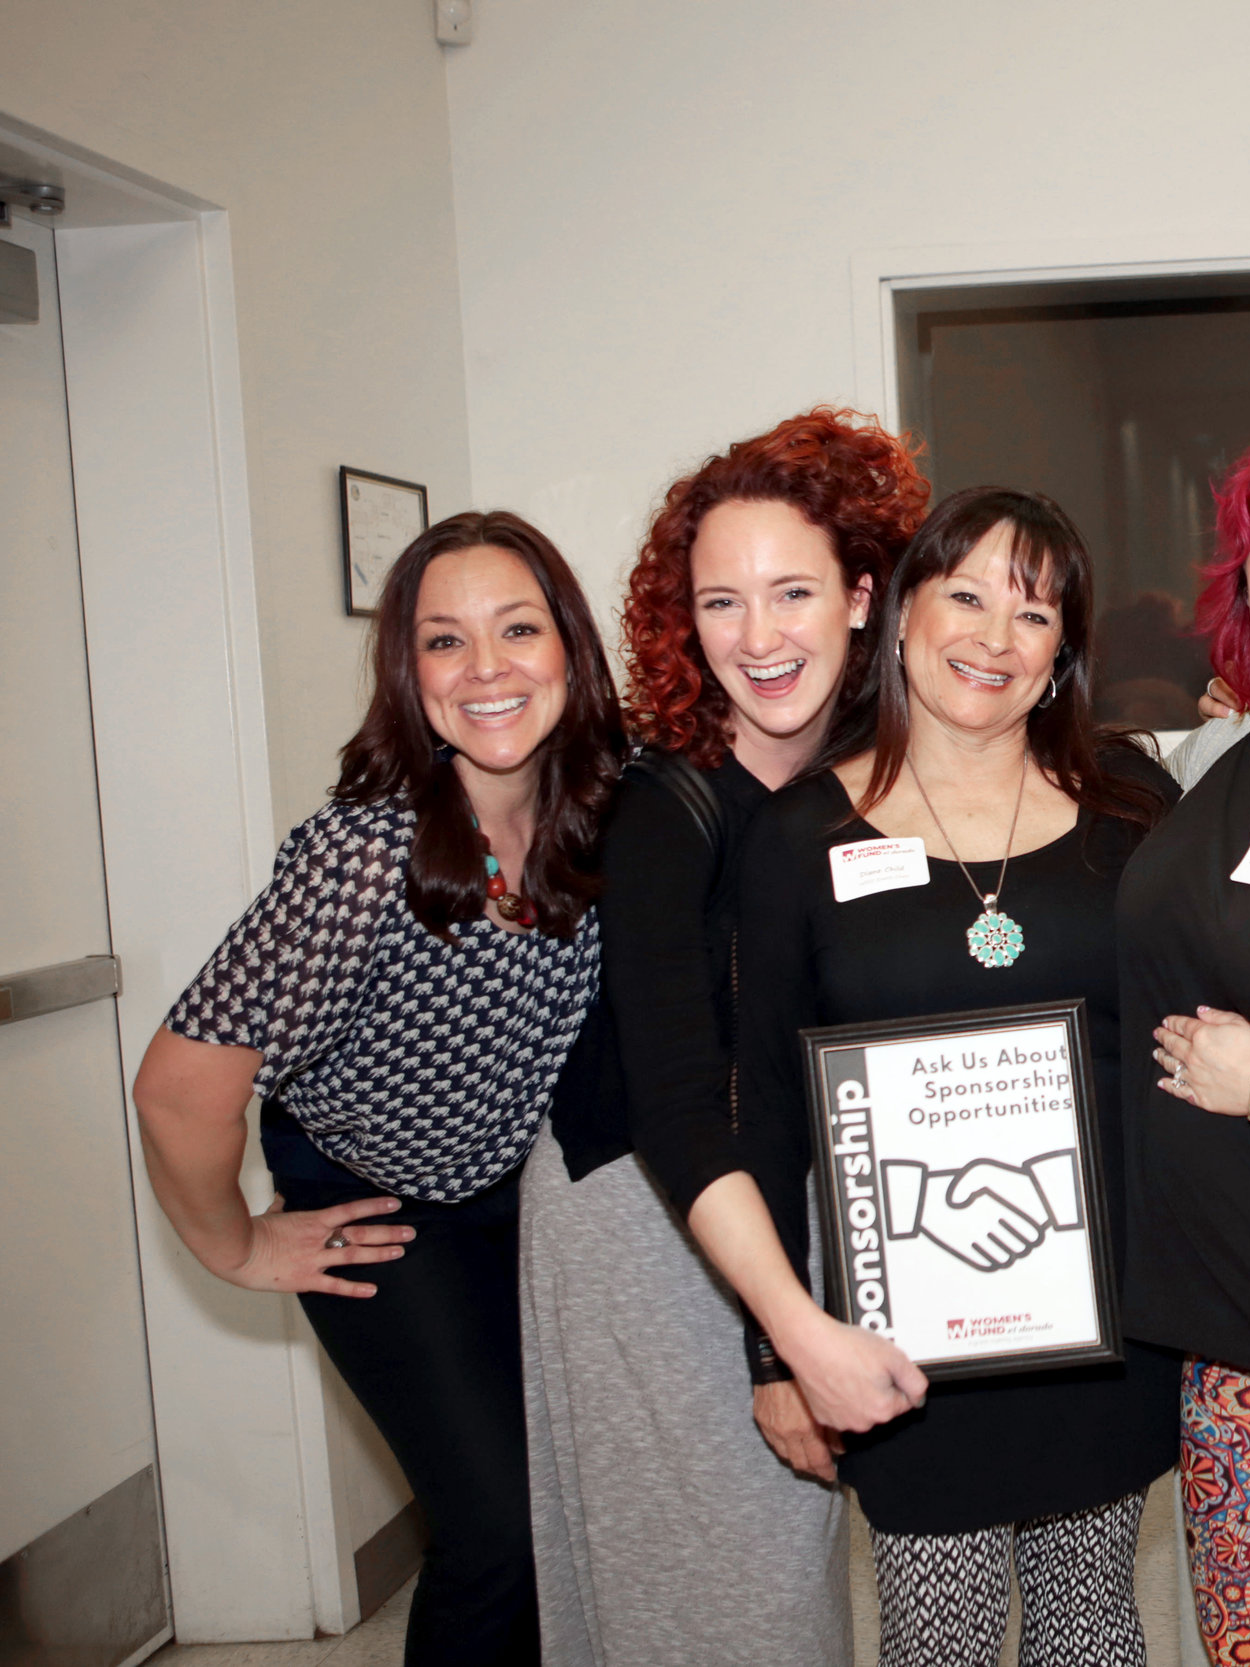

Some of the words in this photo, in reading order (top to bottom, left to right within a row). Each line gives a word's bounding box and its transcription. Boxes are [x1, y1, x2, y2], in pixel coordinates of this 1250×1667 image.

[857, 843, 900, 853] WOMEN'S
[857, 850, 882, 859] FUND
[912, 1054, 954, 1076] Ask
[961, 1051, 988, 1070] Us
[996, 1045, 1068, 1067] About
[924, 1069, 1070, 1103] Sponsorship
[908, 1094, 1073, 1129] Opportunities
[831, 1079, 894, 1341] ponsorship
[970, 1312, 1032, 1327] WOMEN'S
[970, 1326, 1005, 1337] FUND
[1018, 1322, 1054, 1334] dorado
